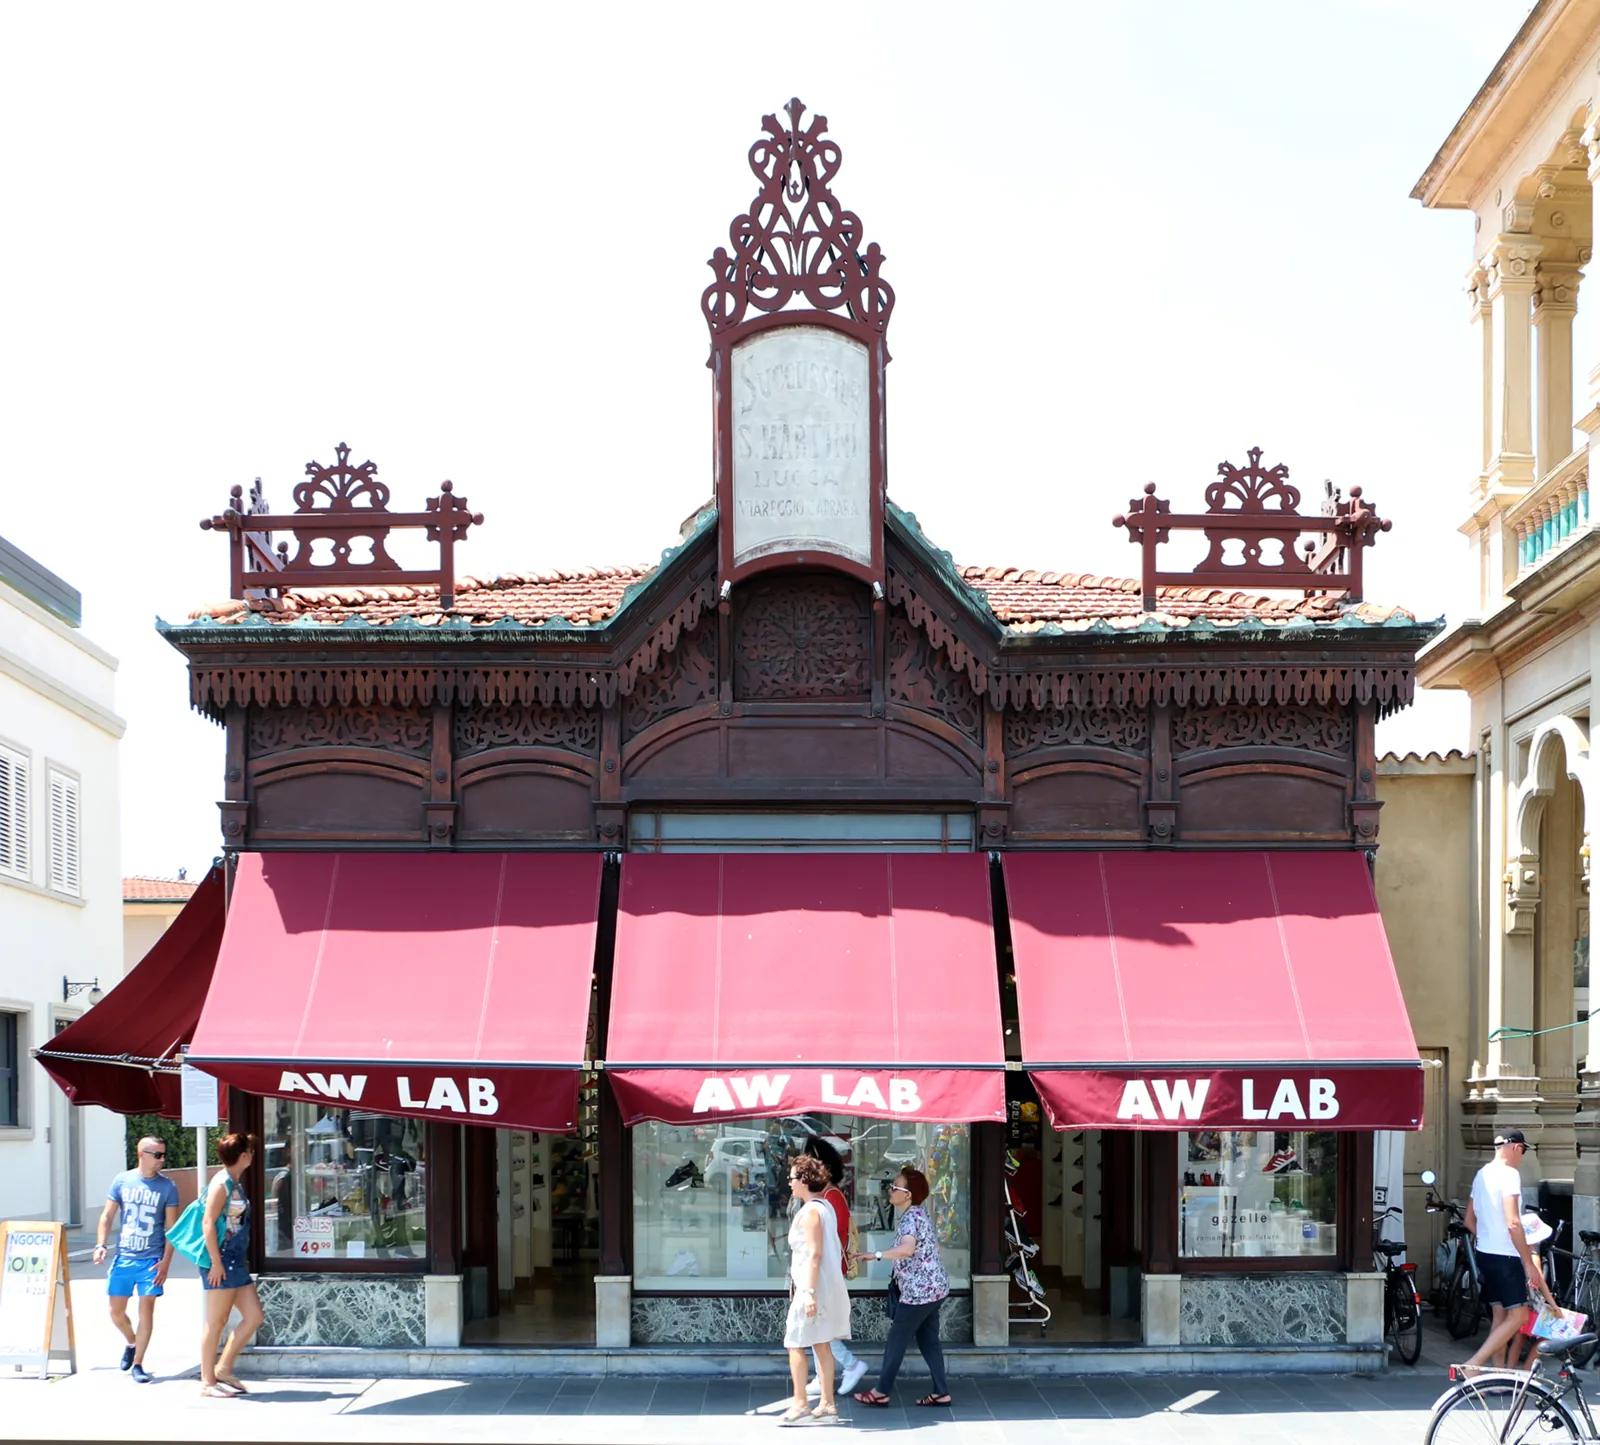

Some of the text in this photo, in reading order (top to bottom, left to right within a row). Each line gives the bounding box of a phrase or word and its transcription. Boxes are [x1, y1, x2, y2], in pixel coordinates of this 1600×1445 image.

[754, 469, 839, 488] LUCCA
[278, 1071, 499, 1116] AW LAB
[692, 1074, 922, 1113] AW LAB
[1116, 1079, 1340, 1120] AW LAB
[294, 1216, 333, 1233] SALES
[1211, 1212, 1268, 1226] gazelle
